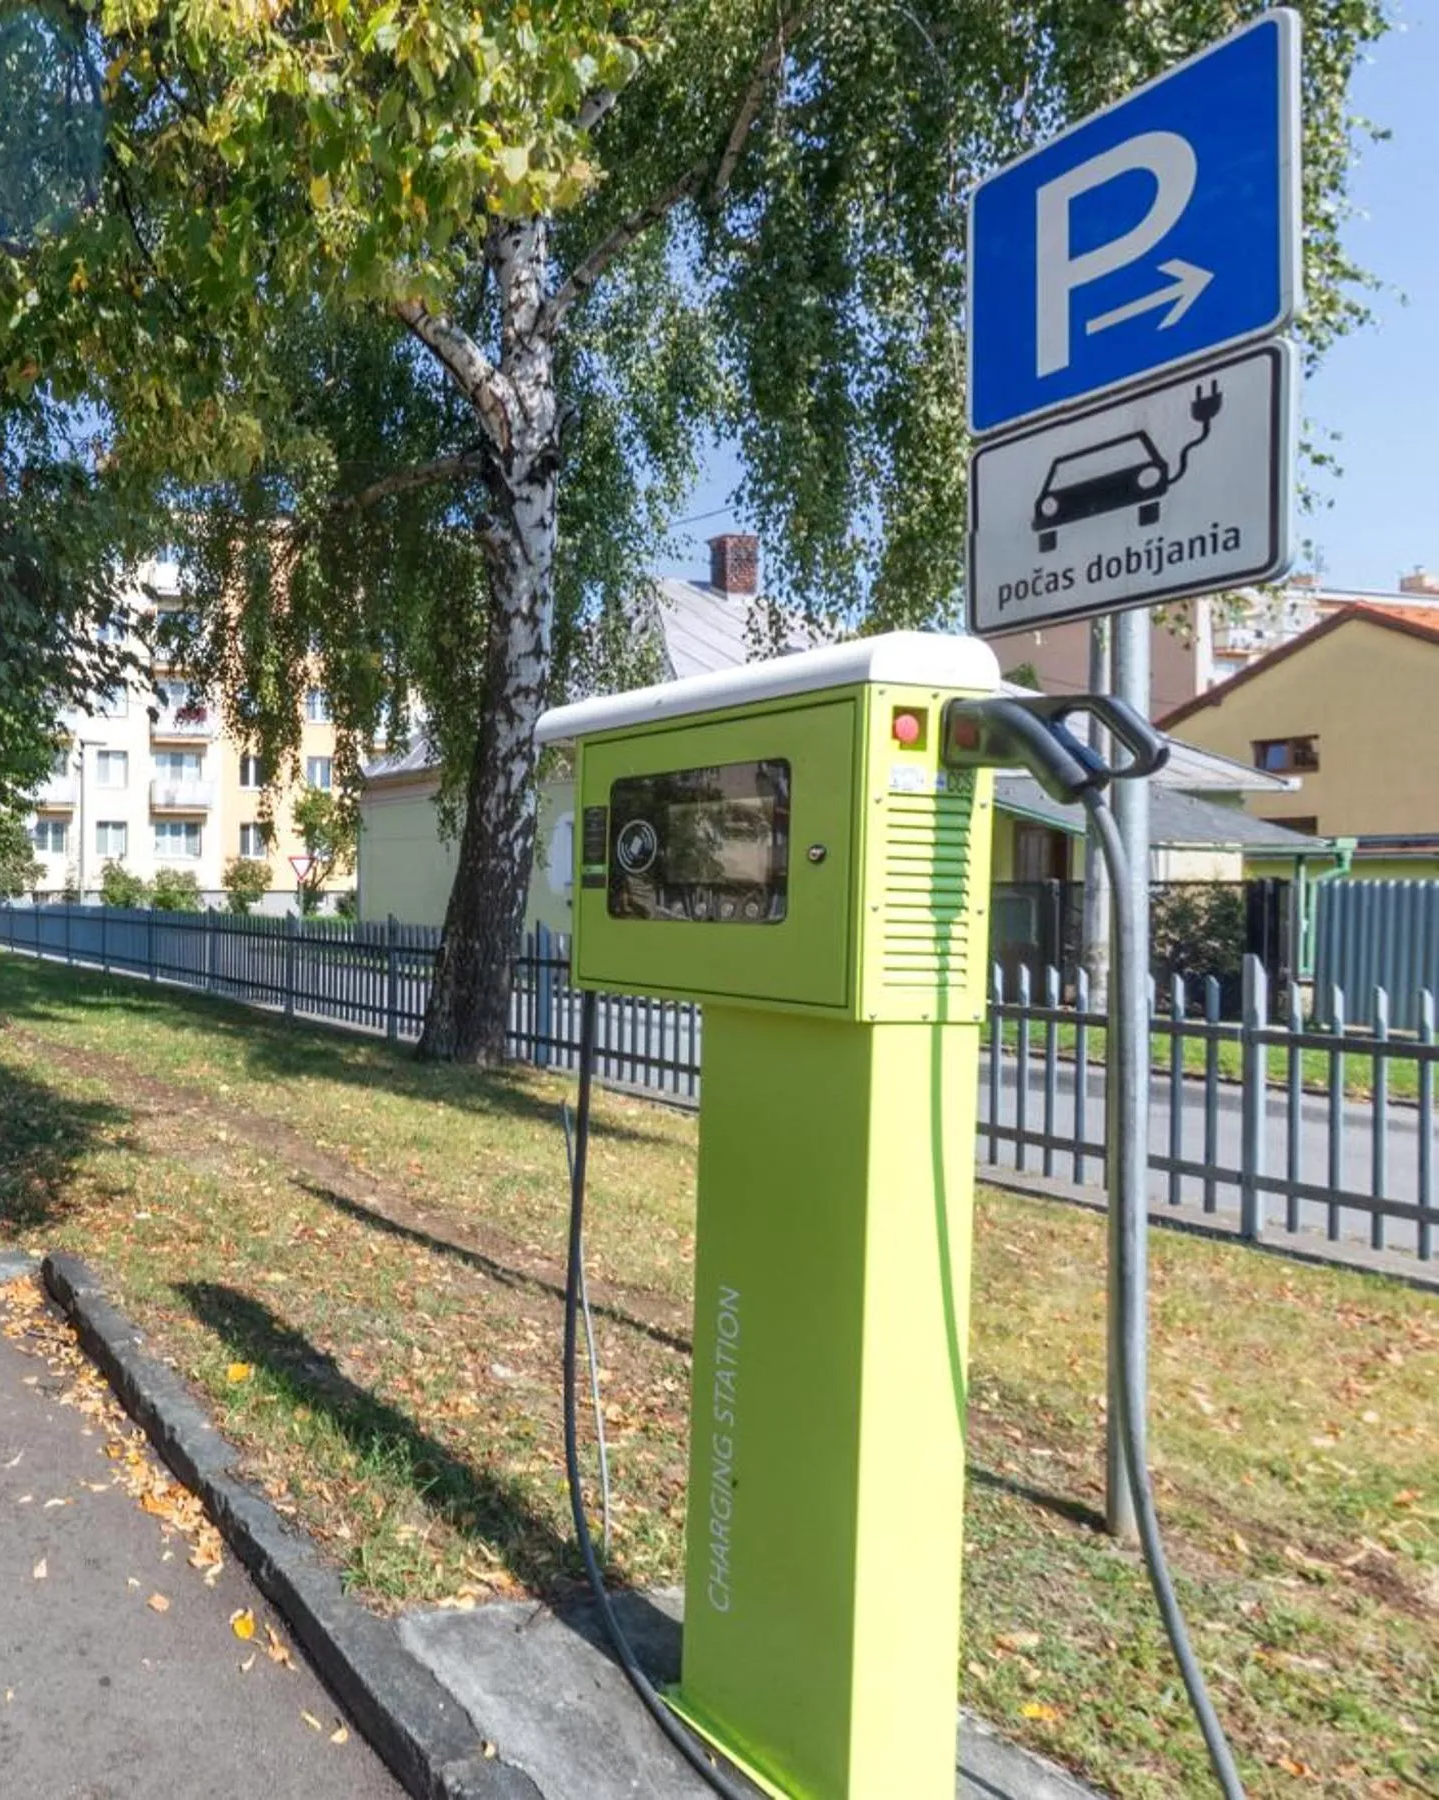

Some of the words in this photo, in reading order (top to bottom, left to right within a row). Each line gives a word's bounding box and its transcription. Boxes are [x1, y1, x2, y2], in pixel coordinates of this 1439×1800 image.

[1036, 130, 1198, 379] P
[997, 566, 1076, 610] počas
[1085, 522, 1241, 584] dobíjania
[712, 1285, 741, 1427] STATION
[707, 1431, 735, 1613] CHARGING
